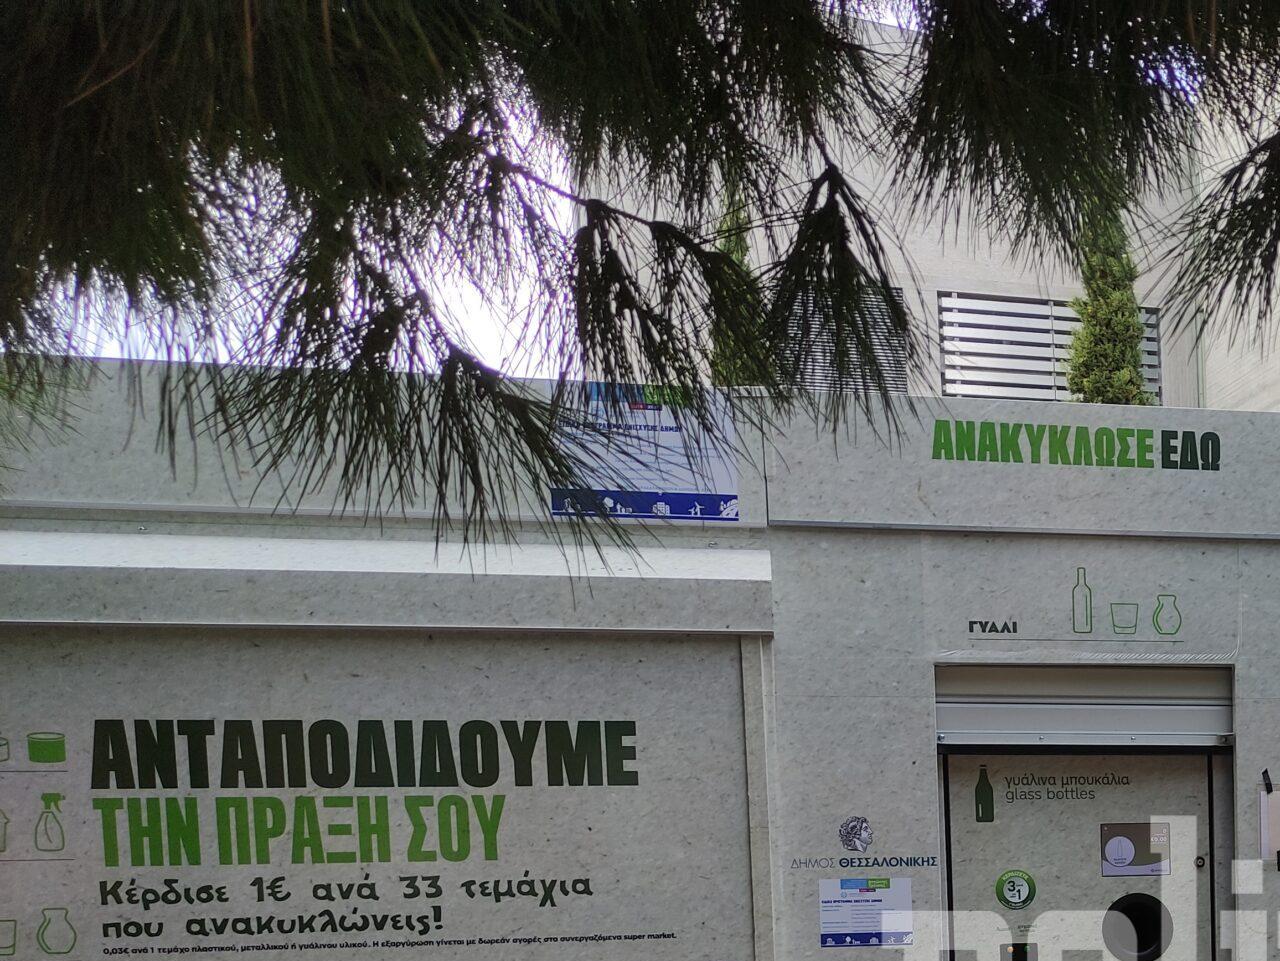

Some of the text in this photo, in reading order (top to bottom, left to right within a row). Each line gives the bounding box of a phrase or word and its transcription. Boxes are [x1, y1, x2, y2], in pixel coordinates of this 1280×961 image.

[932, 419, 1221, 471] ΑΝΑΚΥΚΛΩΣΕ ΕΔΩ
[968, 620, 1018, 634] ΓΥΑΛΙ
[91, 719, 639, 789] ΑΝΤΑΠΟΔΙΔΟΥΜΕ
[1004, 772, 1130, 788] γυάλινα μπουκάλια
[1005, 787, 1096, 803] glass bottles
[92, 794, 506, 868] ΤΗΝ ΠΡΑΞΗ ΣΟΥ
[790, 856, 938, 869] ΔΗΜΟΣ ΘΕΣΣΑΛΟΝΙΚΗΣ
[99, 870, 594, 911] Κέρδισε 1€ ανά 33 τεμάχια
[102, 905, 444, 939] που ανακυκλώνεις!
[103, 947, 130, 956] 0,03€
[131, 946, 149, 955] ανά
[240, 942, 289, 953] μεταλλικού
[298, 941, 338, 951] γυάλινου
[381, 938, 434, 950] εξαργύρωση
[436, 937, 465, 949] γίνεται
[466, 938, 477, 947] με
[478, 936, 511, 947] δωρεάν
[512, 935, 542, 946] αγορές
[624, 932, 646, 942] super
